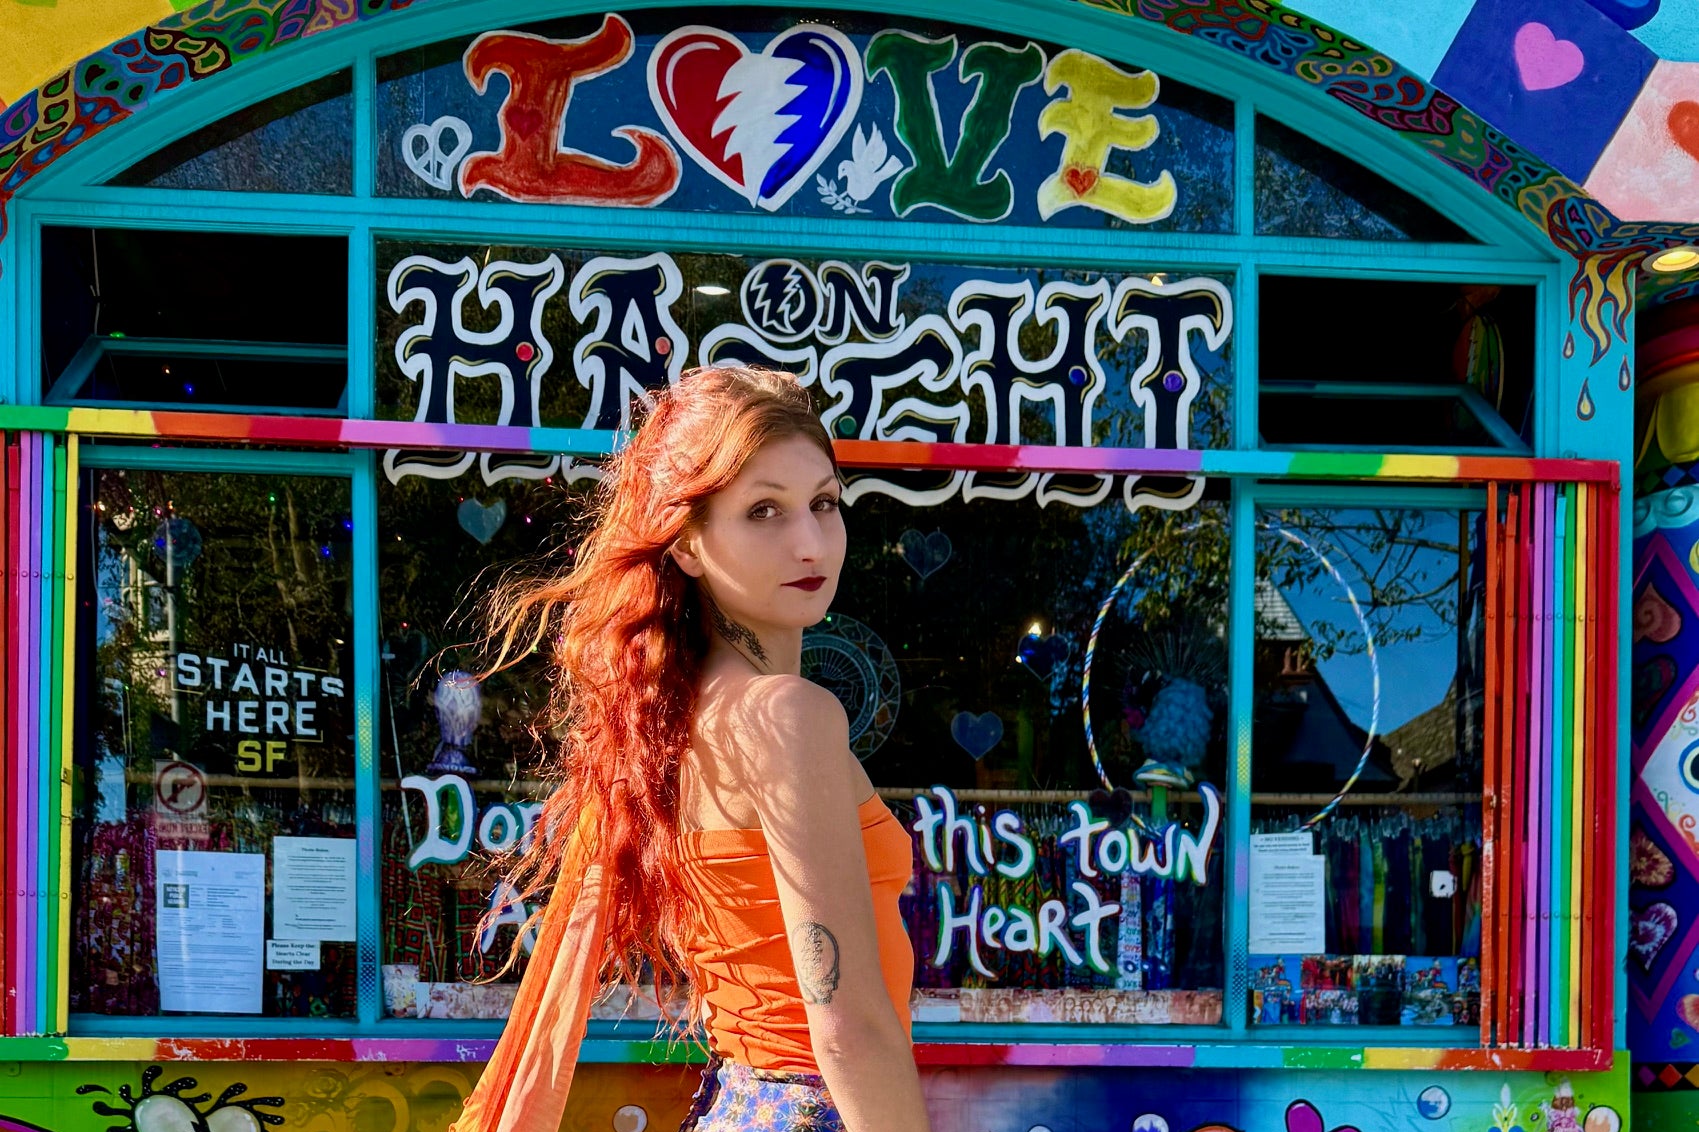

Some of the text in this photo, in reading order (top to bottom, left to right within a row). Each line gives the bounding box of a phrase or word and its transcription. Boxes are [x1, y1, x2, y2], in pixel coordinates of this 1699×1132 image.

[233, 643, 289, 666] IT ALL
[177, 652, 345, 698] STARTS
[206, 700, 317, 736] HERE
[237, 740, 288, 773] SF
[913, 784, 1034, 879] this
